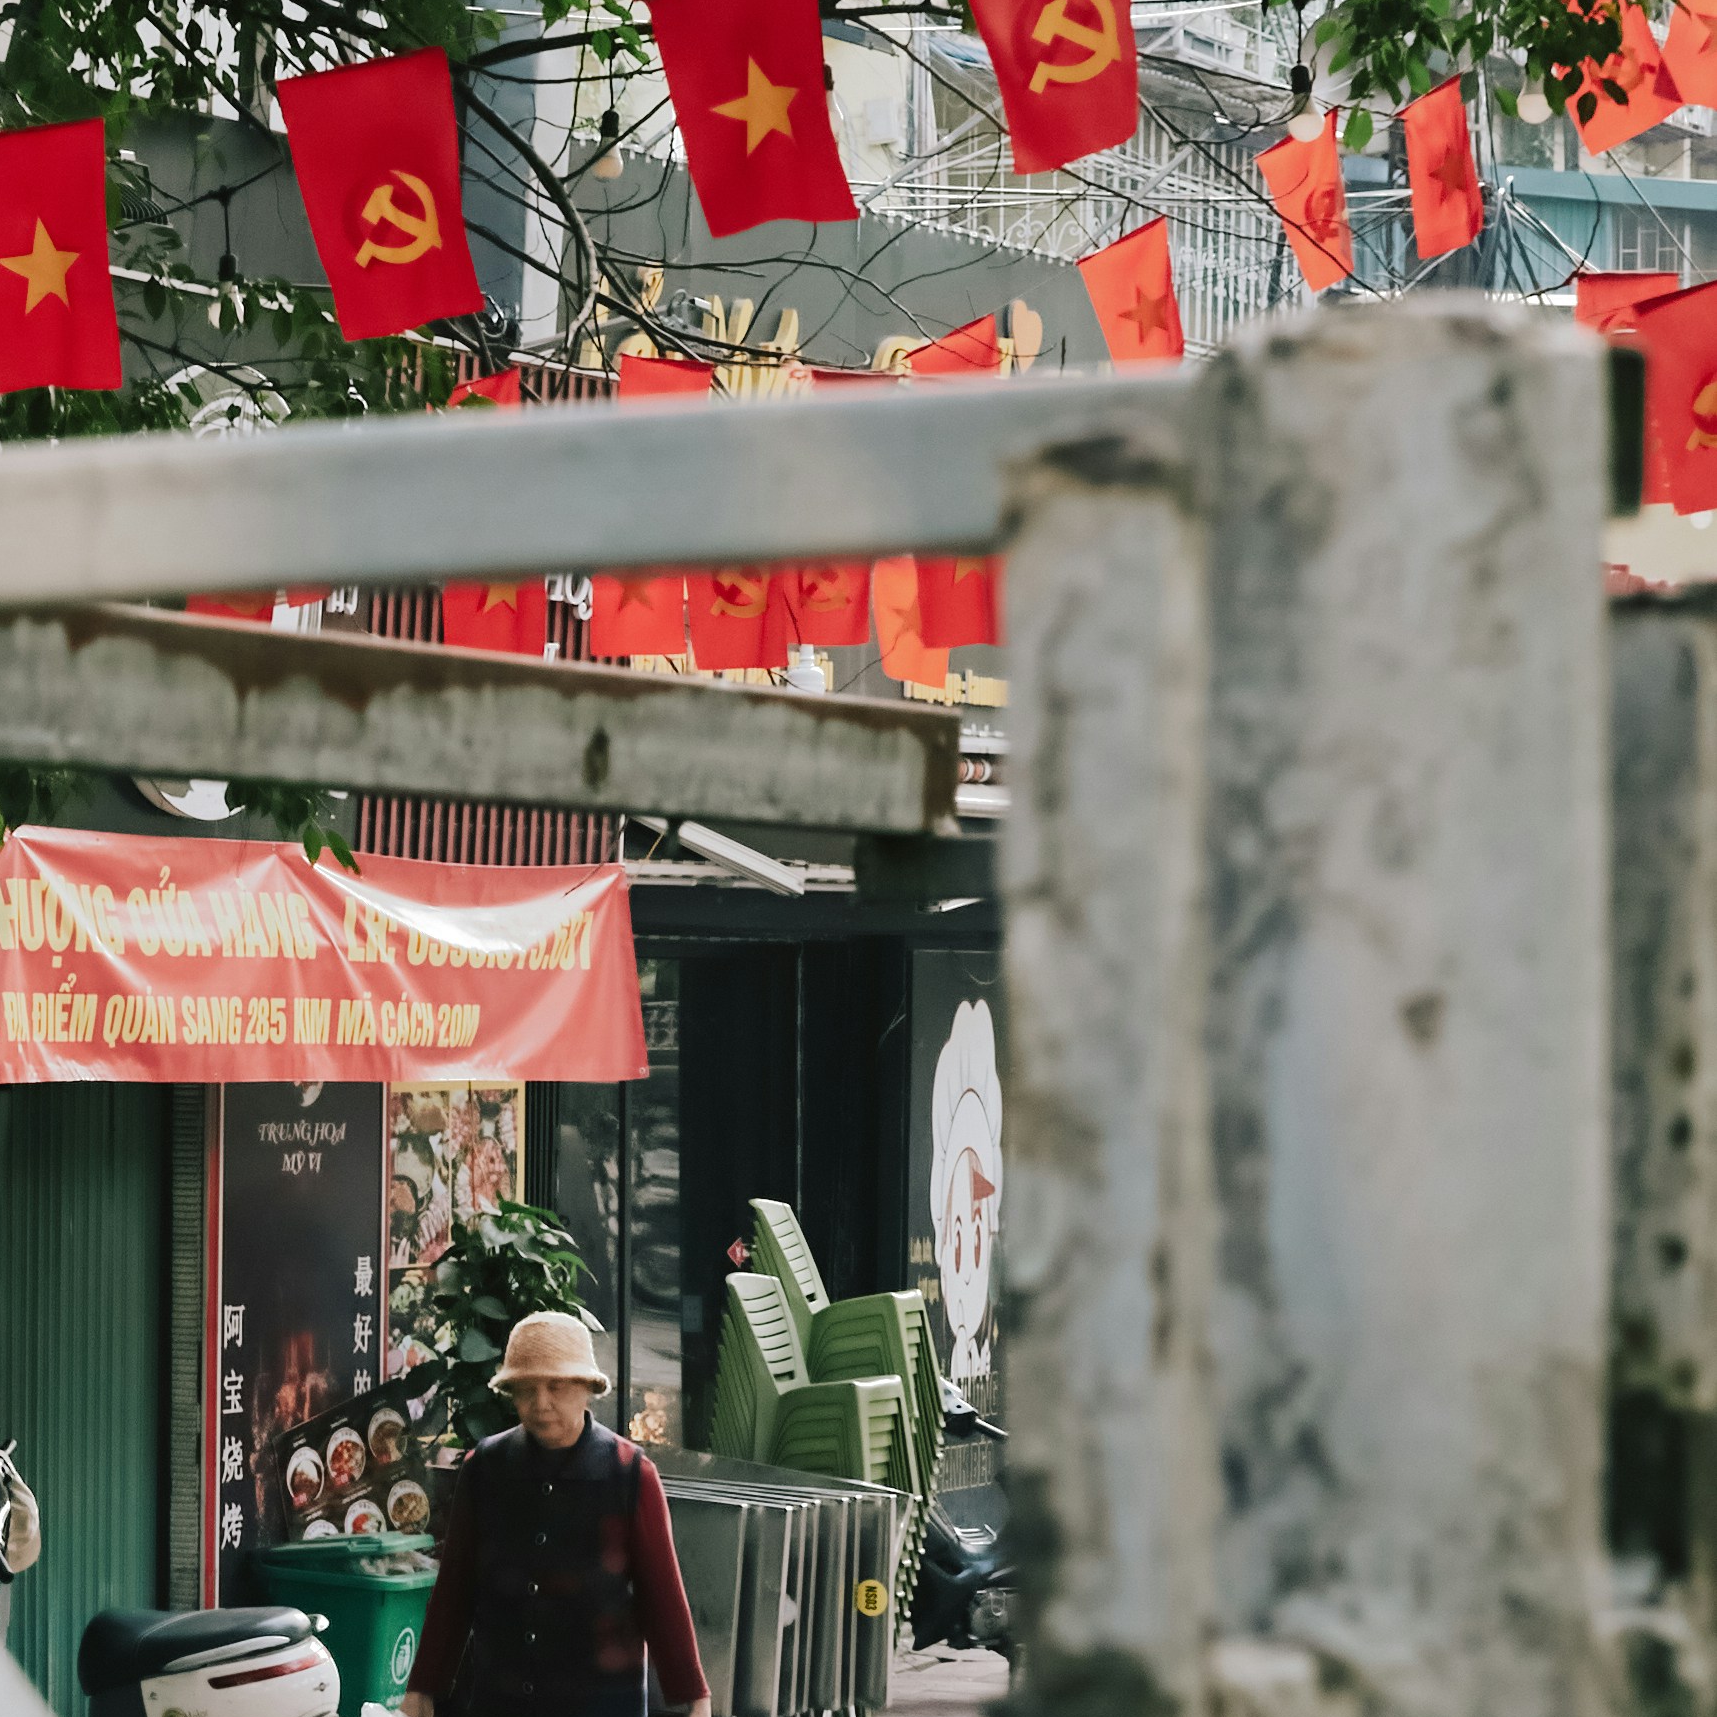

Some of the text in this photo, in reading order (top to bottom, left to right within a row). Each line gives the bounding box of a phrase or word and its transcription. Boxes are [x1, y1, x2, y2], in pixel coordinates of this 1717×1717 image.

[126, 865, 209, 957] CỬA
[211, 877, 316, 960] HÀNG
[32, 972, 98, 1043] ĐIỂM
[182, 995, 242, 1045] SANG
[245, 996, 286, 1044] 285
[293, 996, 331, 1045] KIM
[337, 991, 376, 1046] MÃ
[381, 991, 434, 1047] CÁCH
[437, 1003, 480, 1048] 20M
[258, 1120, 312, 1144] TRUNG
[220, 1304, 246, 1550] 阿宝烧烤
[865, 1585, 877, 1610] NS03
